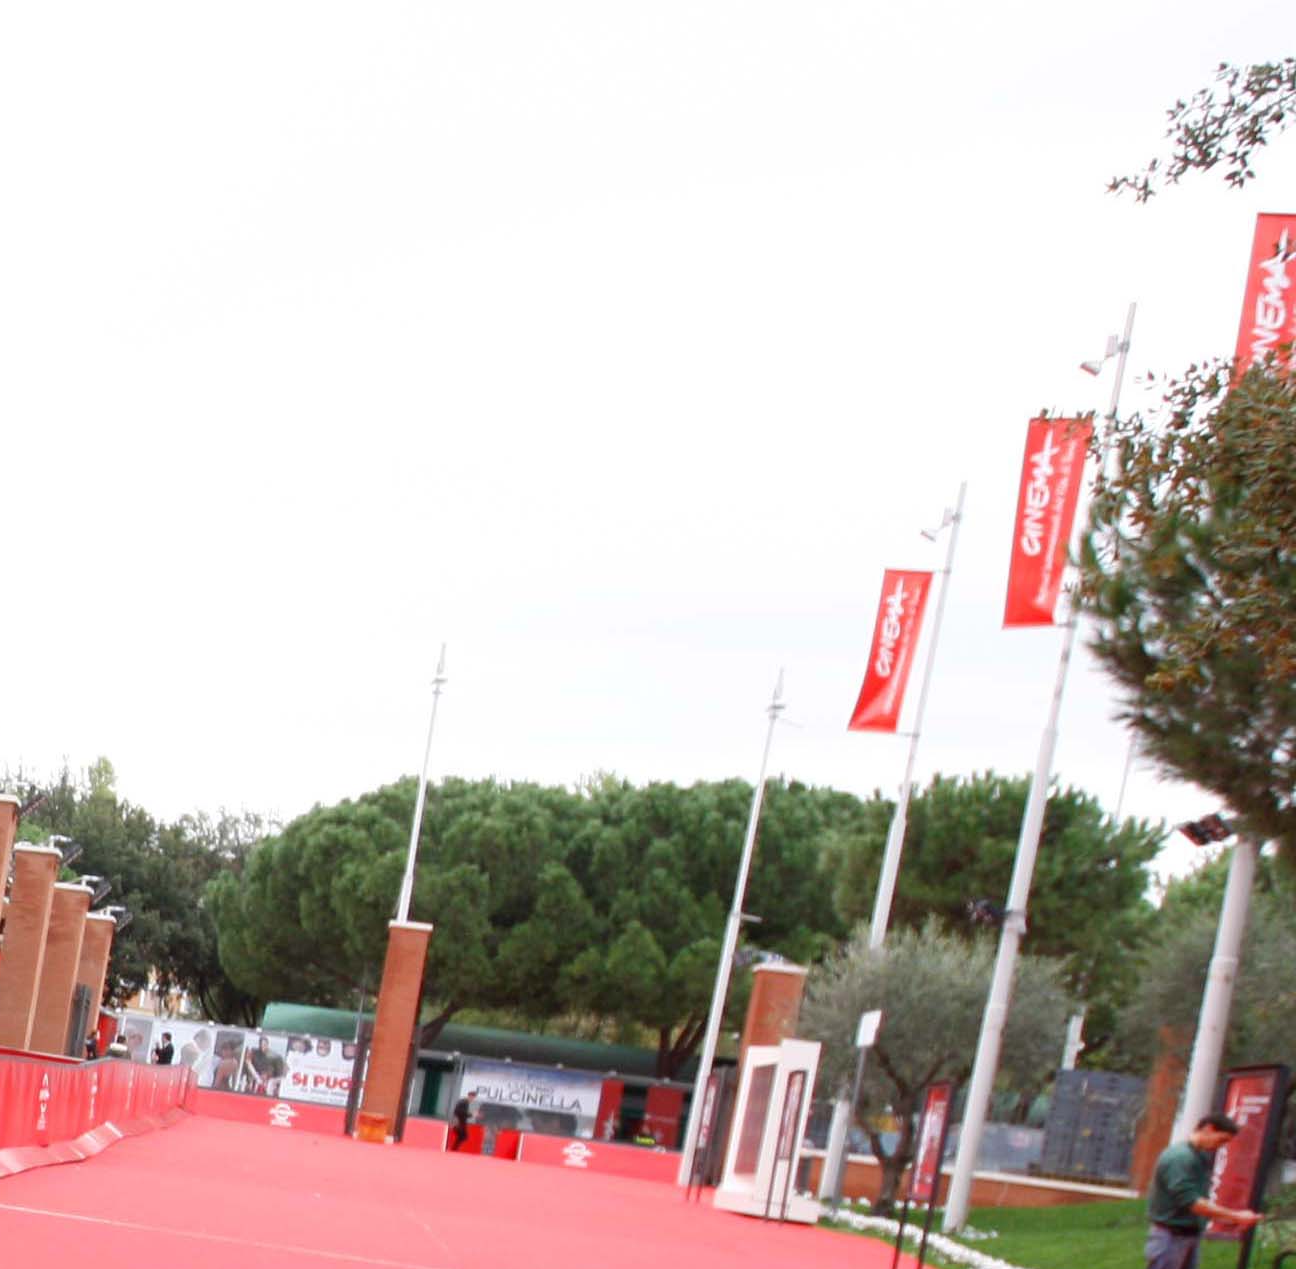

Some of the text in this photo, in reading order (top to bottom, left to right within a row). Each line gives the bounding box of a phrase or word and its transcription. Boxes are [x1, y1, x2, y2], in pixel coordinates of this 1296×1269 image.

[1021, 428, 1059, 557] CINEMA
[875, 576, 909, 678] CINEMA
[292, 1072, 308, 1087] SI
[475, 1085, 582, 1113] PULCINELLA
